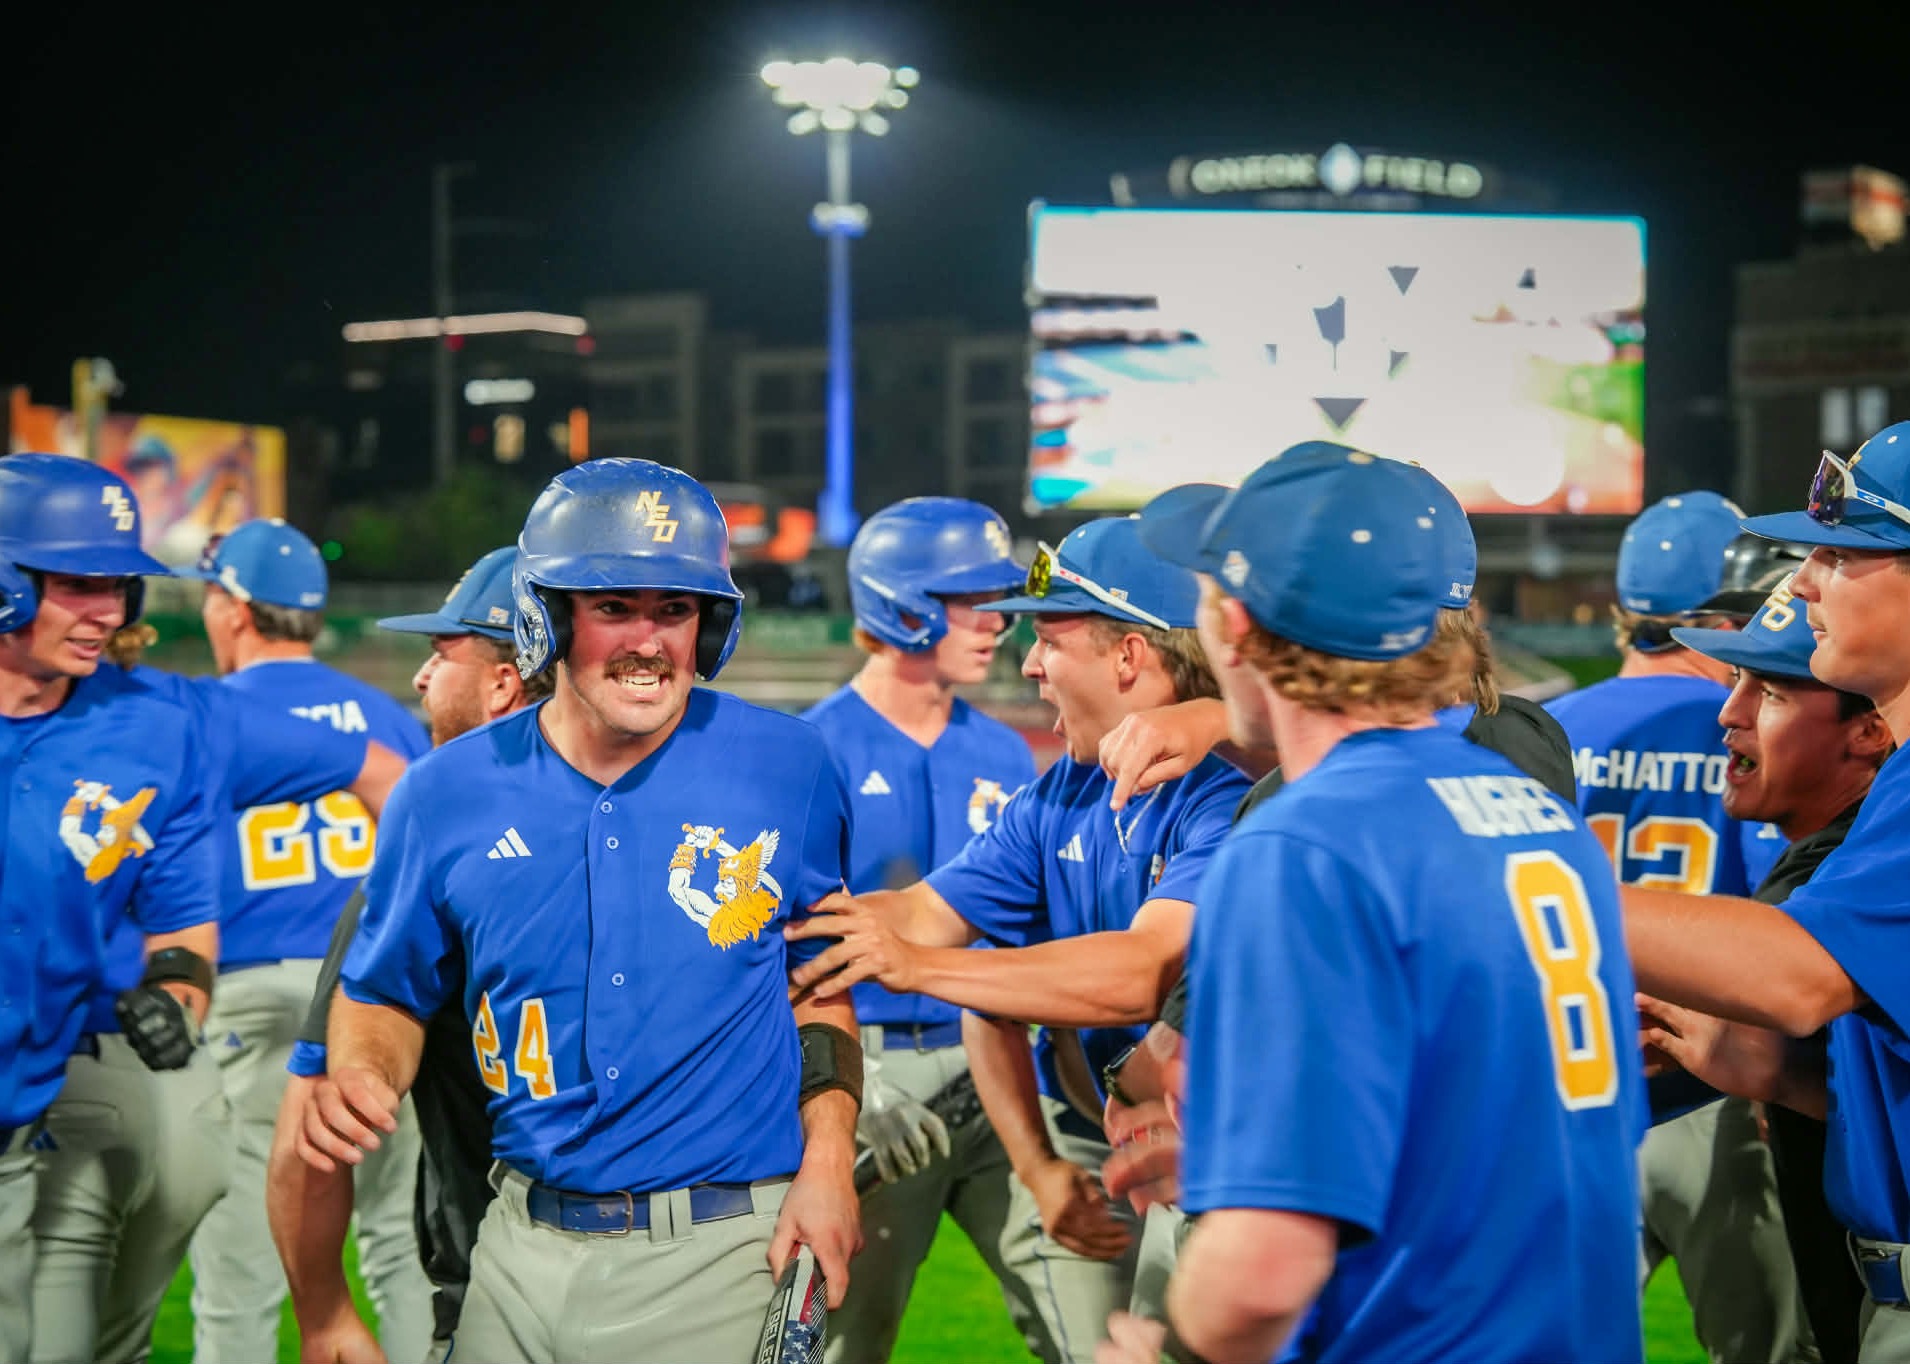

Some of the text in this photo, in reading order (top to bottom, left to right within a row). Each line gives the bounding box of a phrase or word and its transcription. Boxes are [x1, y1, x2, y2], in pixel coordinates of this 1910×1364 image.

[1363, 154, 1483, 198] FIELD
[635, 490, 679, 543] NEO
[1426, 774, 1577, 838] HUGHES
[1505, 849, 1619, 1111] 8
[473, 990, 557, 1101] 24
